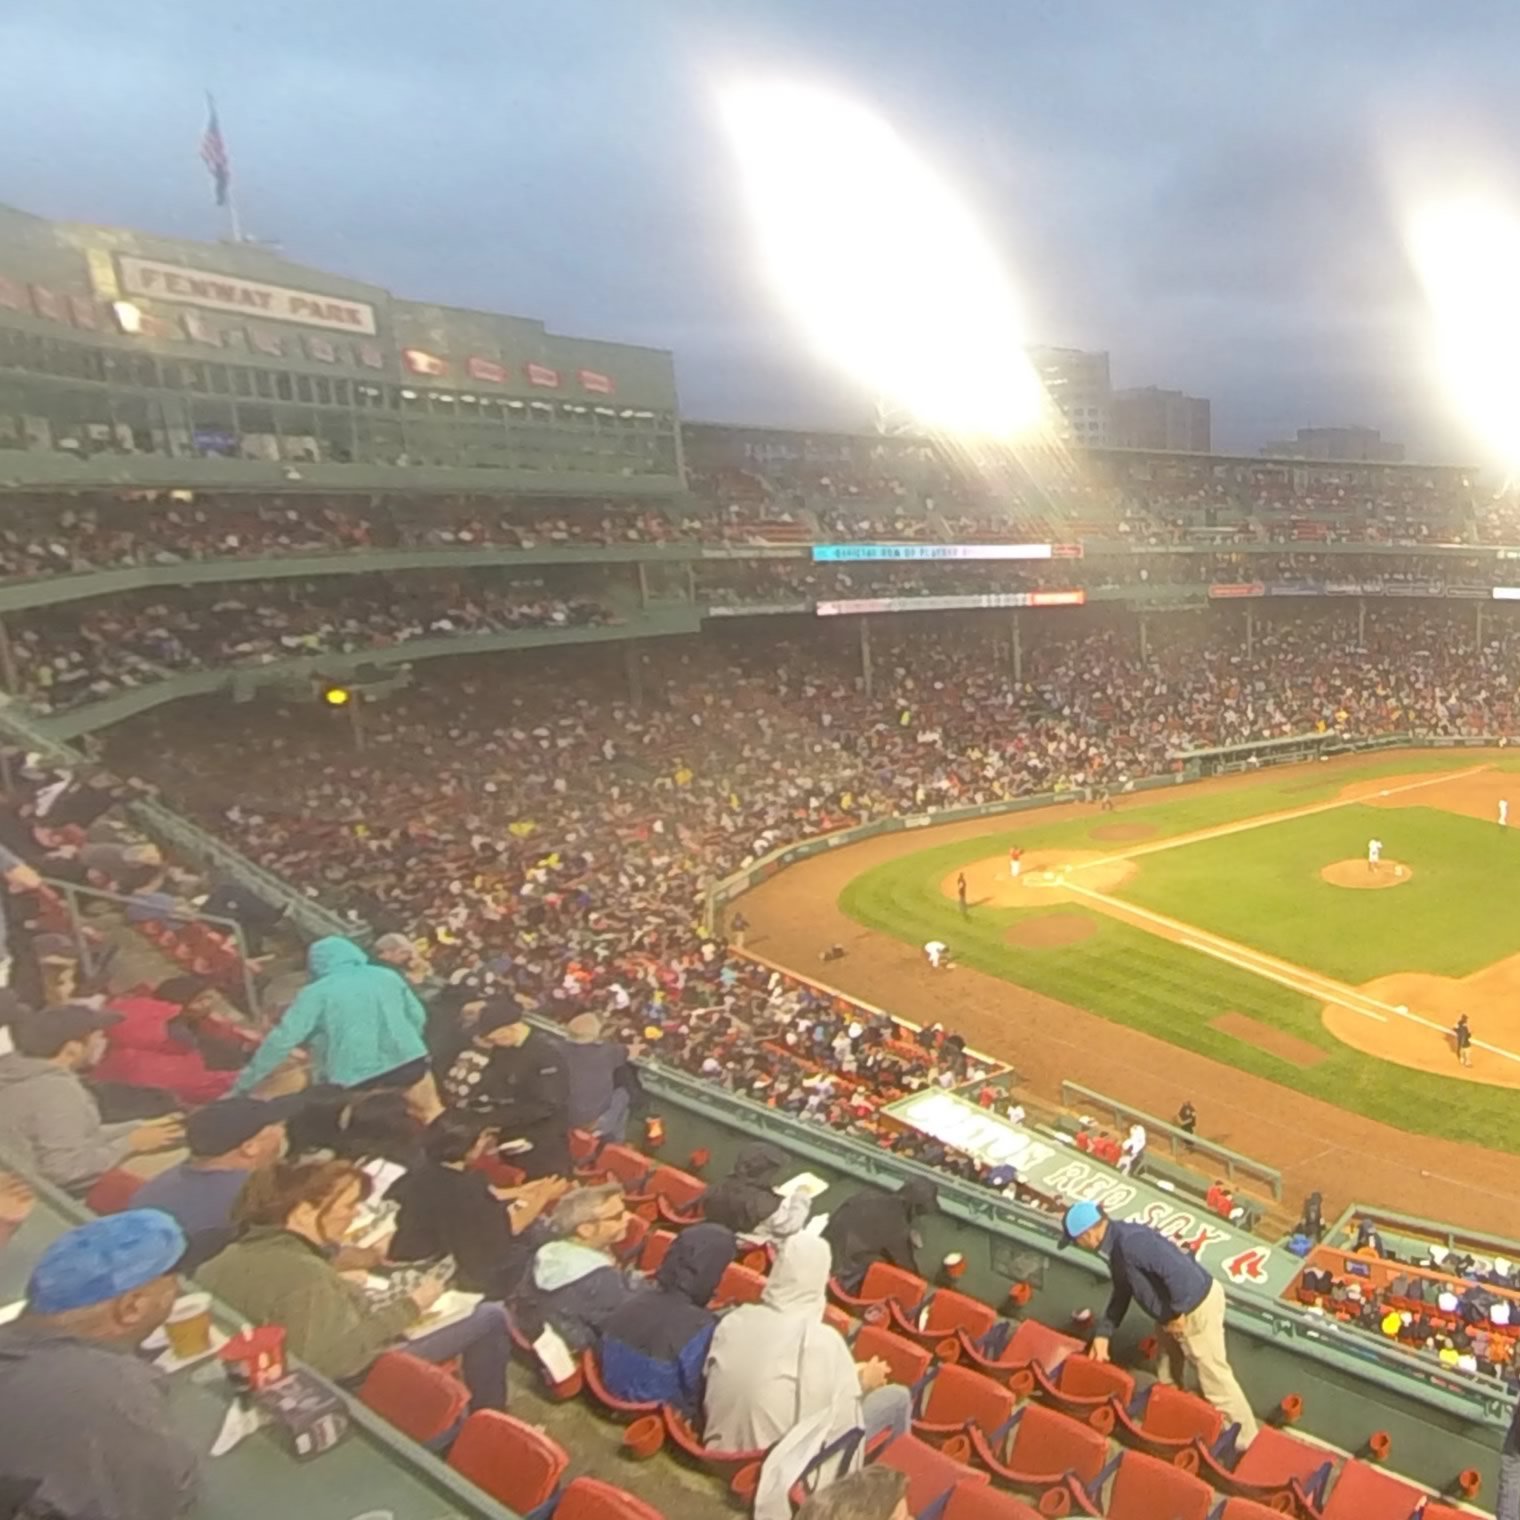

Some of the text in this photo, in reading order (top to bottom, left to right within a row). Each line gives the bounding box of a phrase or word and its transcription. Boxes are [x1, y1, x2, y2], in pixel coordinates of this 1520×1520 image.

[140, 267, 363, 325] FENWAY PARK
[1045, 1161, 1137, 1212] RED
[1125, 1202, 1232, 1264] SOX
